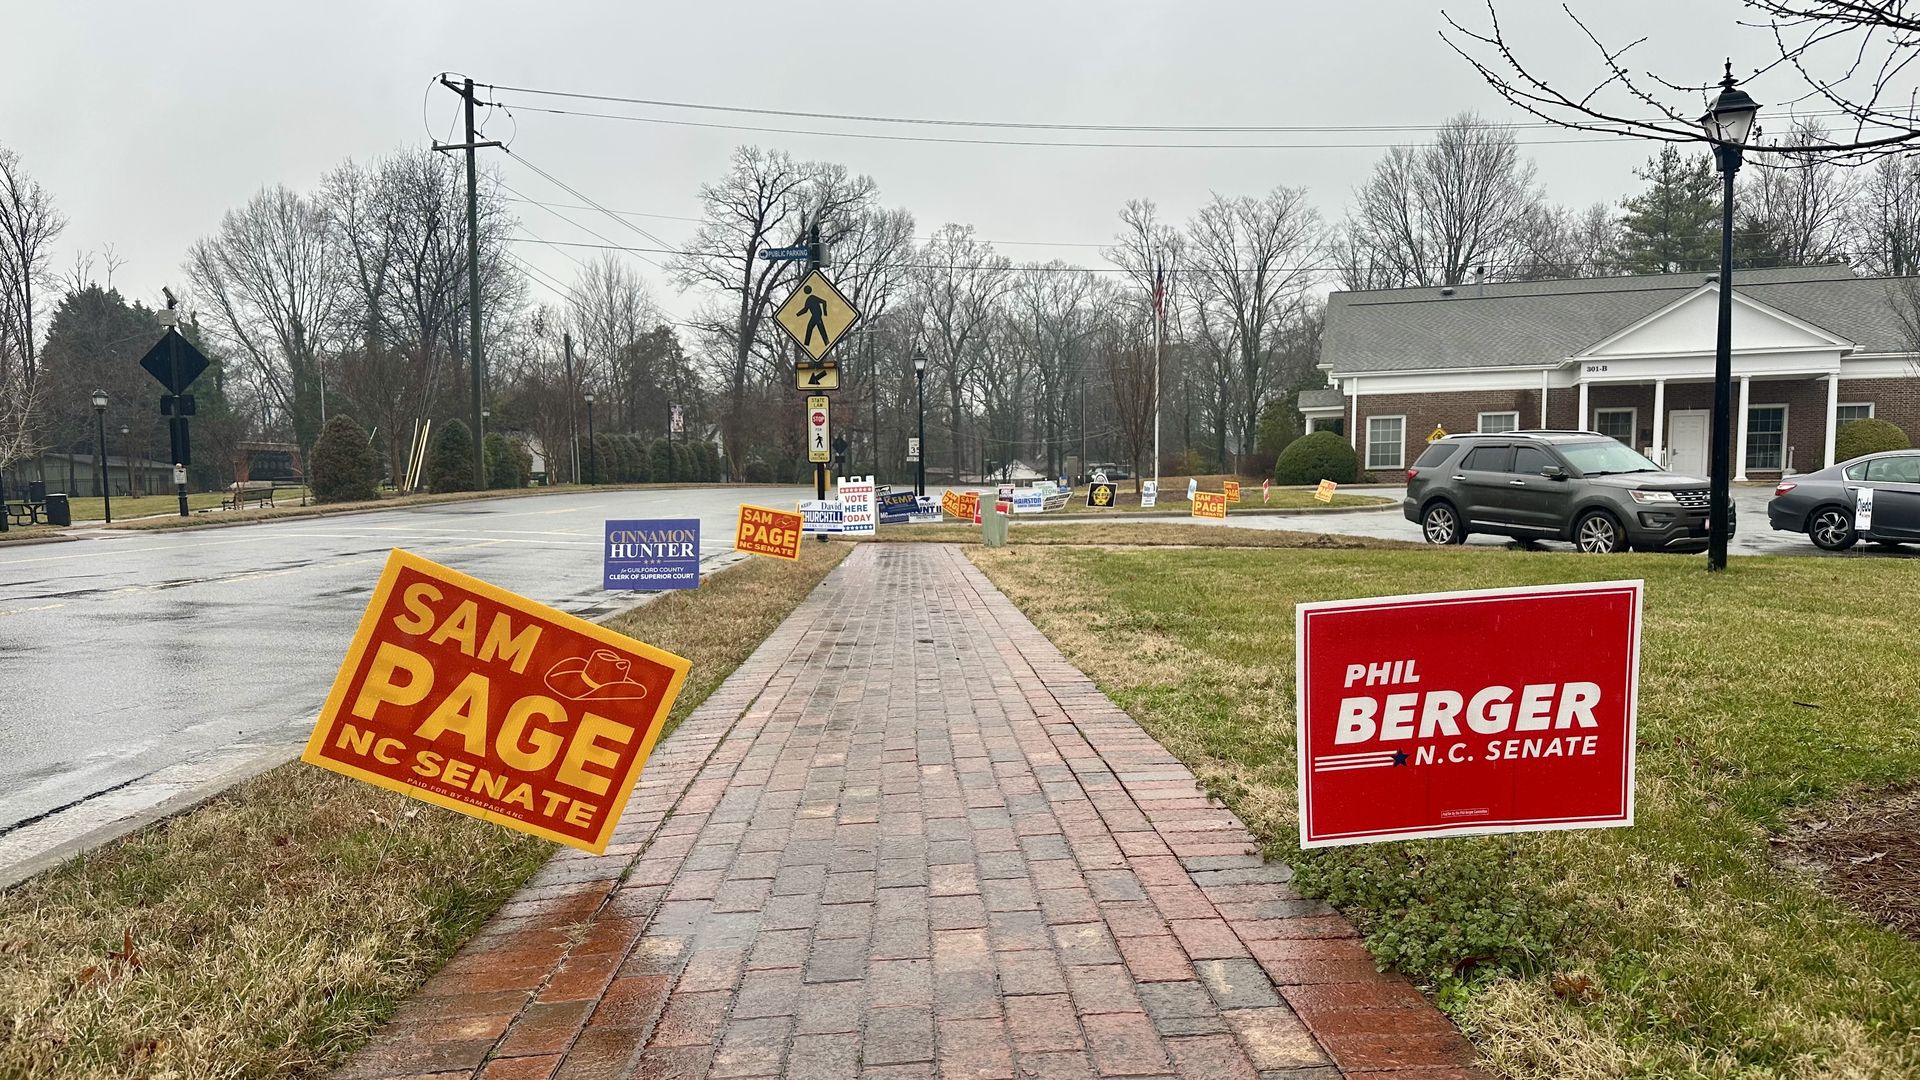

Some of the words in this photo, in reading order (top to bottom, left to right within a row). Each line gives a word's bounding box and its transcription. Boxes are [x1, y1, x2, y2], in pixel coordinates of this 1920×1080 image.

[821, 502, 842, 510] David
[845, 495, 868, 503] VOTE
[942, 496, 958, 510] PAG
[845, 504, 868, 513] HERE
[960, 504, 974, 514] PA
[1195, 502, 1224, 513] PAGE
[744, 509, 773, 525] SAM
[843, 514, 872, 523] TODAY
[610, 529, 696, 543] CINNAMON
[740, 522, 797, 549] PAGE
[610, 543, 695, 558] HUNTER
[739, 540, 754, 549] NC
[754, 543, 795, 557] SENATE
[393, 582, 544, 675] SAM
[1344, 660, 1420, 688] PHIL
[351, 641, 635, 796] PAGE
[1334, 681, 1602, 745] BERGER
[1415, 743, 1474, 766] N.C.
[1485, 735, 1599, 761] SENATE
[335, 724, 407, 764] NC
[412, 750, 597, 829] SENATE
[406, 777, 428, 788] PAID
[430, 785, 447, 795] FOR
